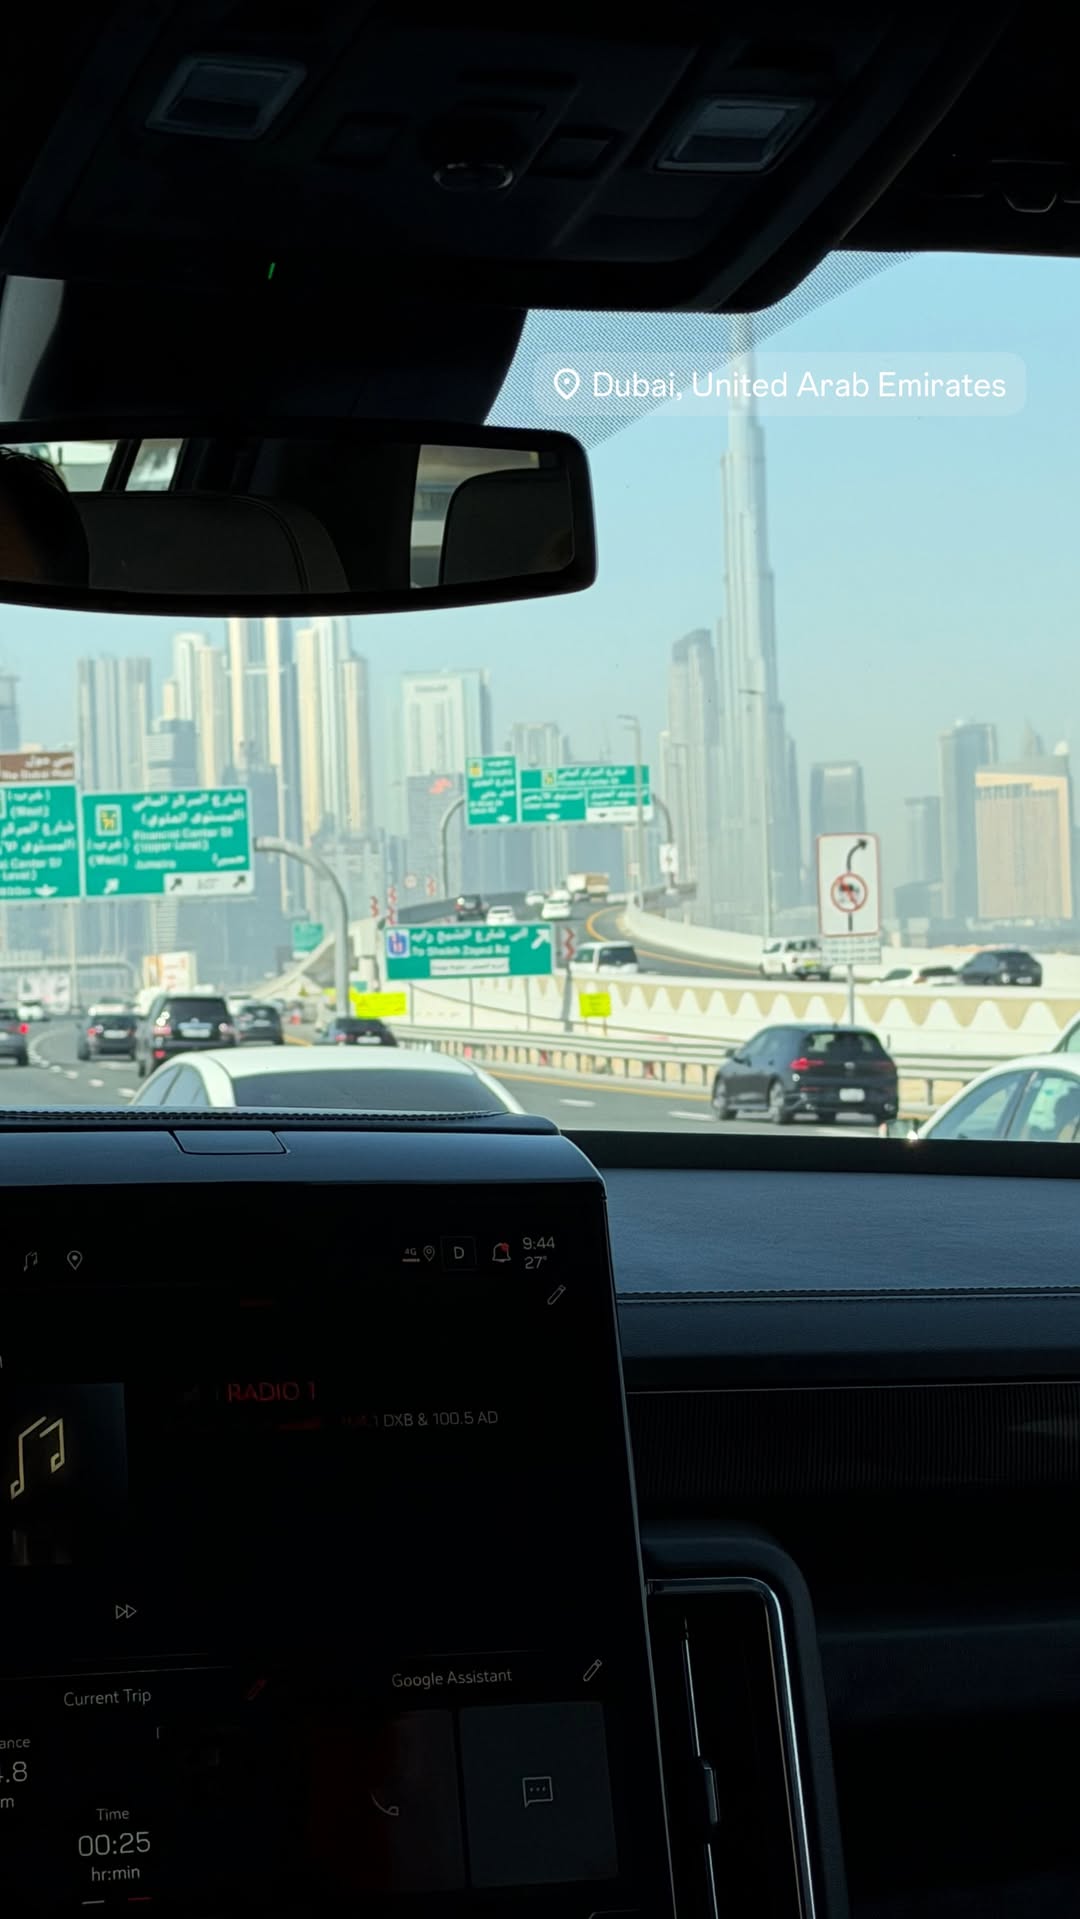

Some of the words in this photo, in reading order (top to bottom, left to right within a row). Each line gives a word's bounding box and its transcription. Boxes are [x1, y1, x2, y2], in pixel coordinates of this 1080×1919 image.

[404, 1247, 417, 1256] 4G
[453, 1245, 465, 1260] D
[522, 1236, 556, 1251] 9:44
[524, 1255, 548, 1270] 27°
[226, 1381, 301, 1403] RADIO
[383, 1411, 414, 1428] DXB
[416, 1412, 429, 1426] &
[431, 1411, 475, 1427] 100.5
[476, 1410, 499, 1425] AD
[391, 1671, 444, 1690] Google
[447, 1667, 513, 1685] Assistant
[63, 1689, 121, 1708] Current
[122, 1687, 152, 1707] Trip
[96, 1807, 130, 1822] Time
[77, 1830, 151, 1857] 00:25
[91, 1864, 141, 1882] hr:min
